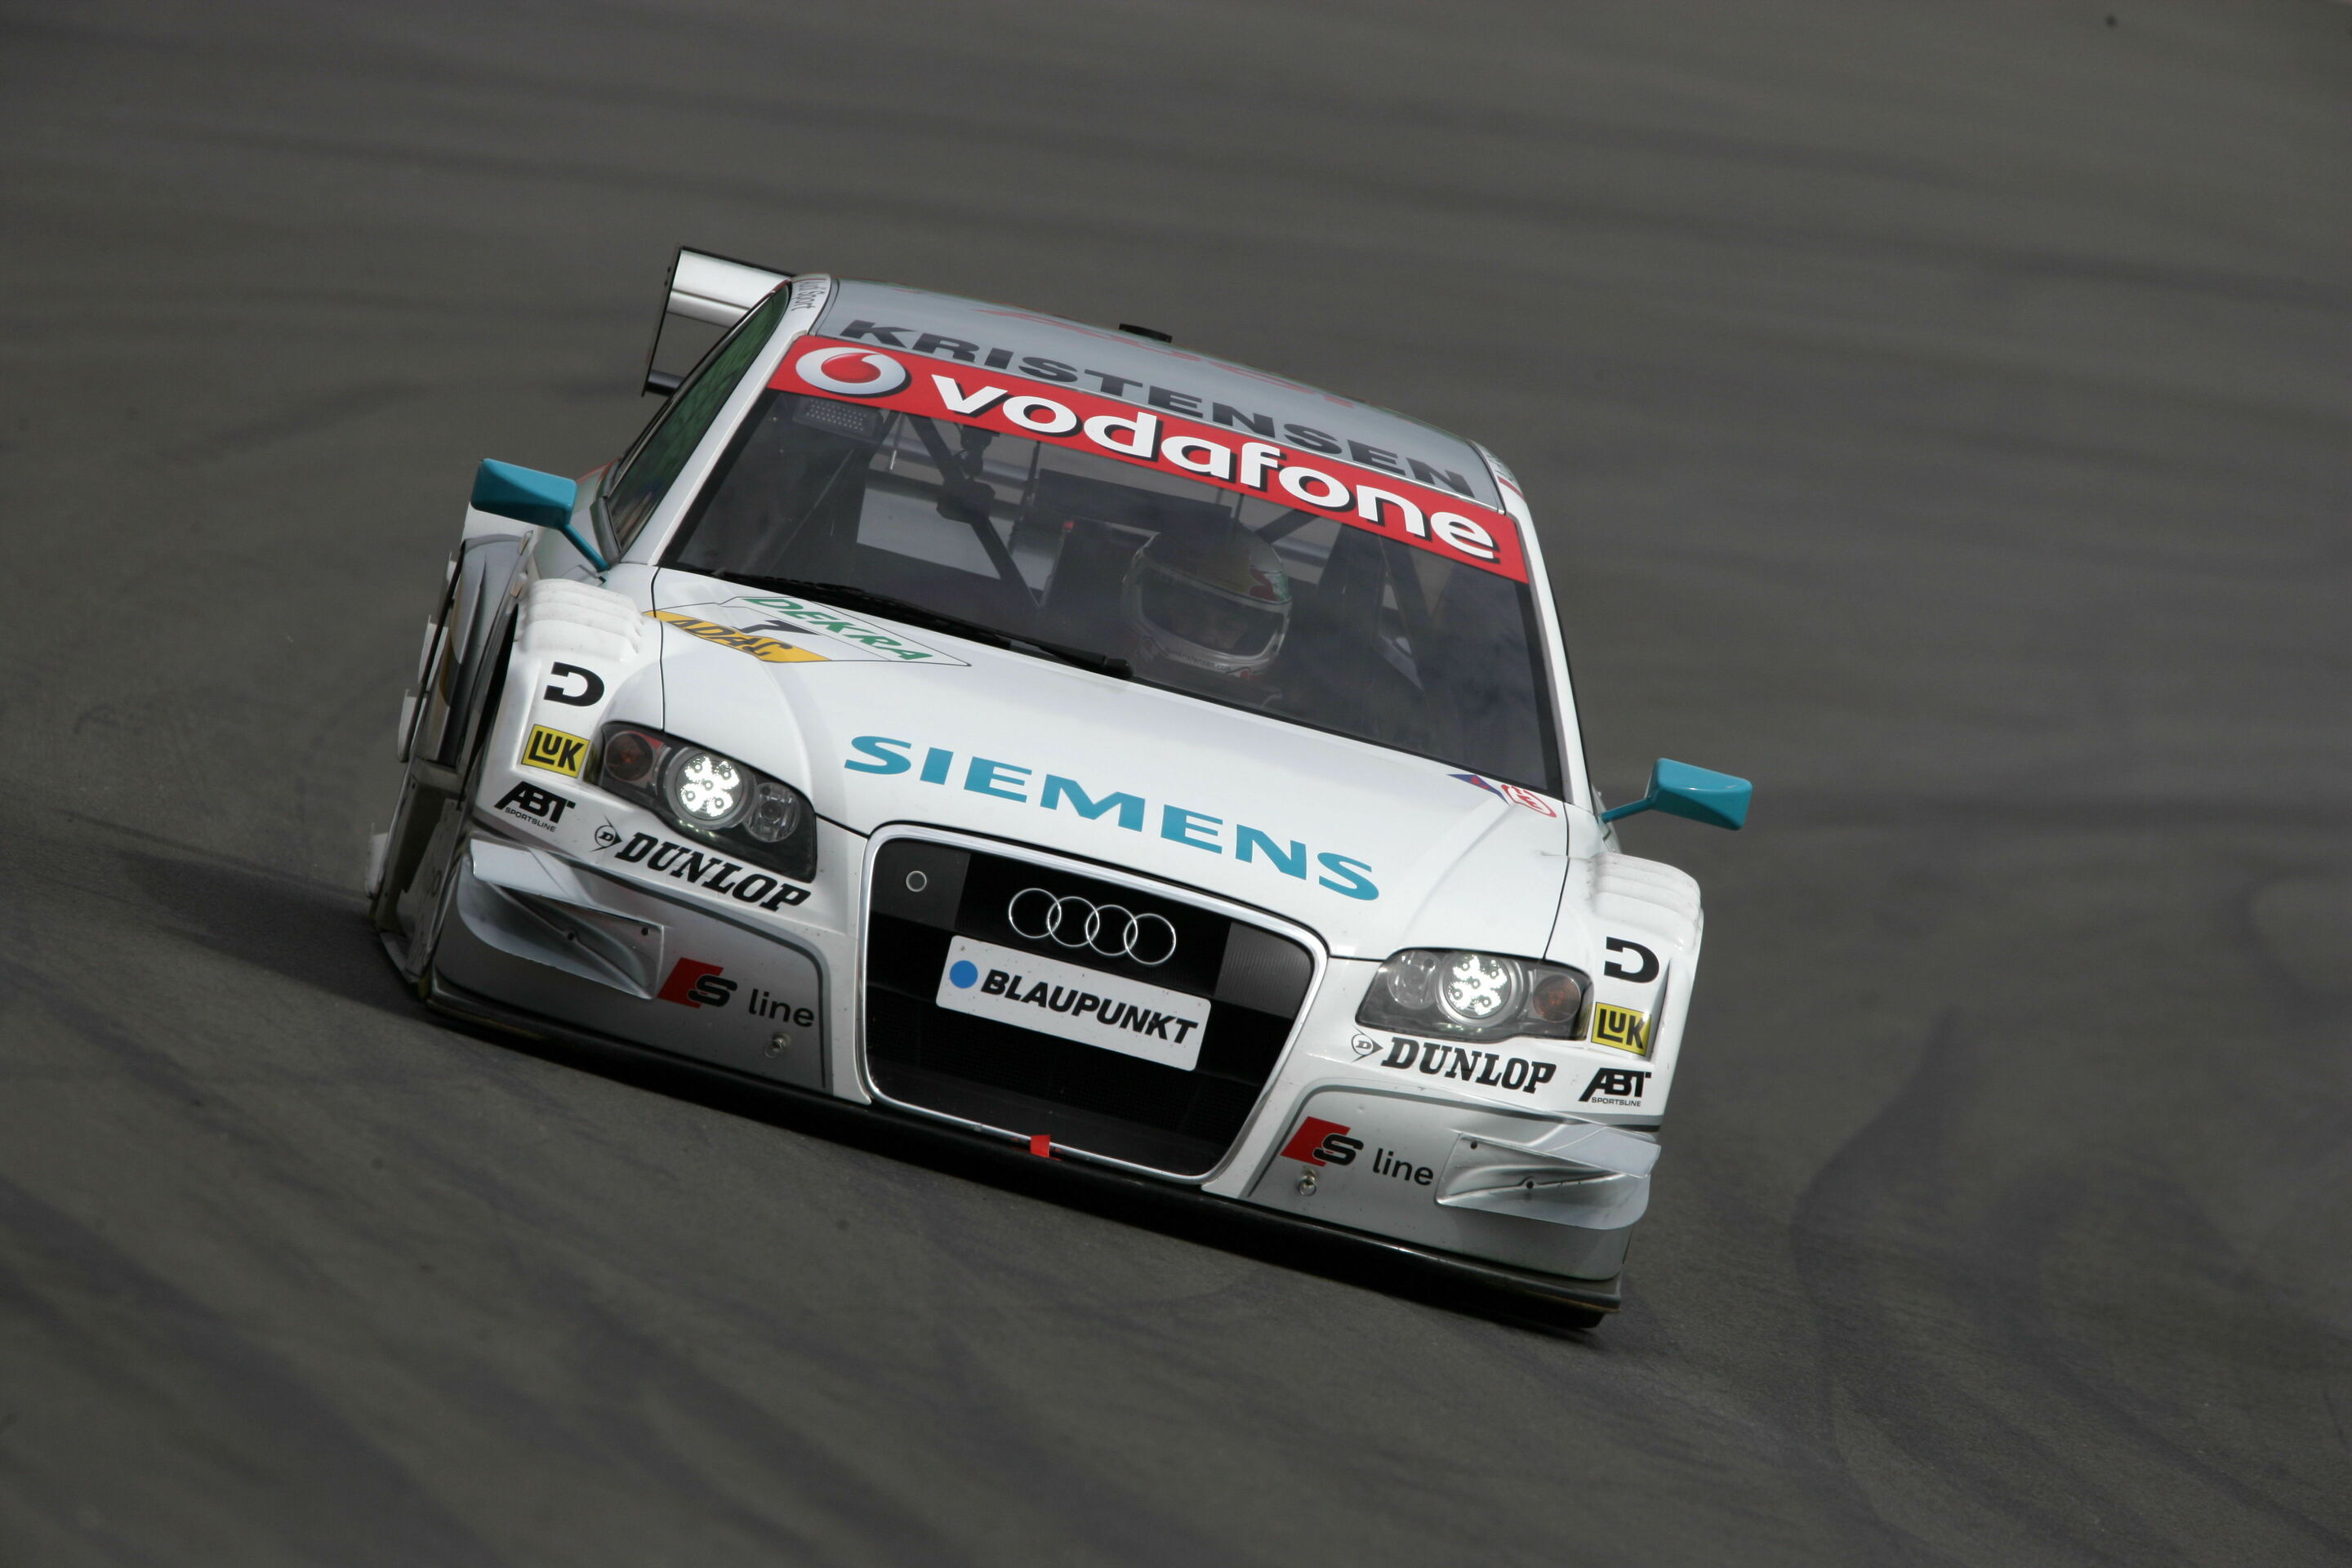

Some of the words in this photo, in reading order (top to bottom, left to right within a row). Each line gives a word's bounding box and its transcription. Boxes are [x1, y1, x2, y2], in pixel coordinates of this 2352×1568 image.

[840, 319, 1475, 497] KRISTENSEN
[931, 374, 1497, 562] vodafone
[666, 619, 792, 656] ADAC
[745, 598, 933, 660] DEKRA
[494, 781, 576, 824] ABT
[505, 806, 556, 832] SPORTSLINE
[844, 736, 1379, 901] SIEMENS
[614, 831, 812, 912] DUNLOP
[688, 974, 737, 1007] S
[748, 988, 814, 1027] line
[981, 969, 1197, 1045] BLAUPUNKT
[1381, 1036, 1557, 1094] DUNLOP
[1579, 1067, 1651, 1102] ABT
[1592, 1097, 1642, 1107] SPORTSLINE
[1312, 1134, 1364, 1165] S
[1373, 1147, 1434, 1187] line
